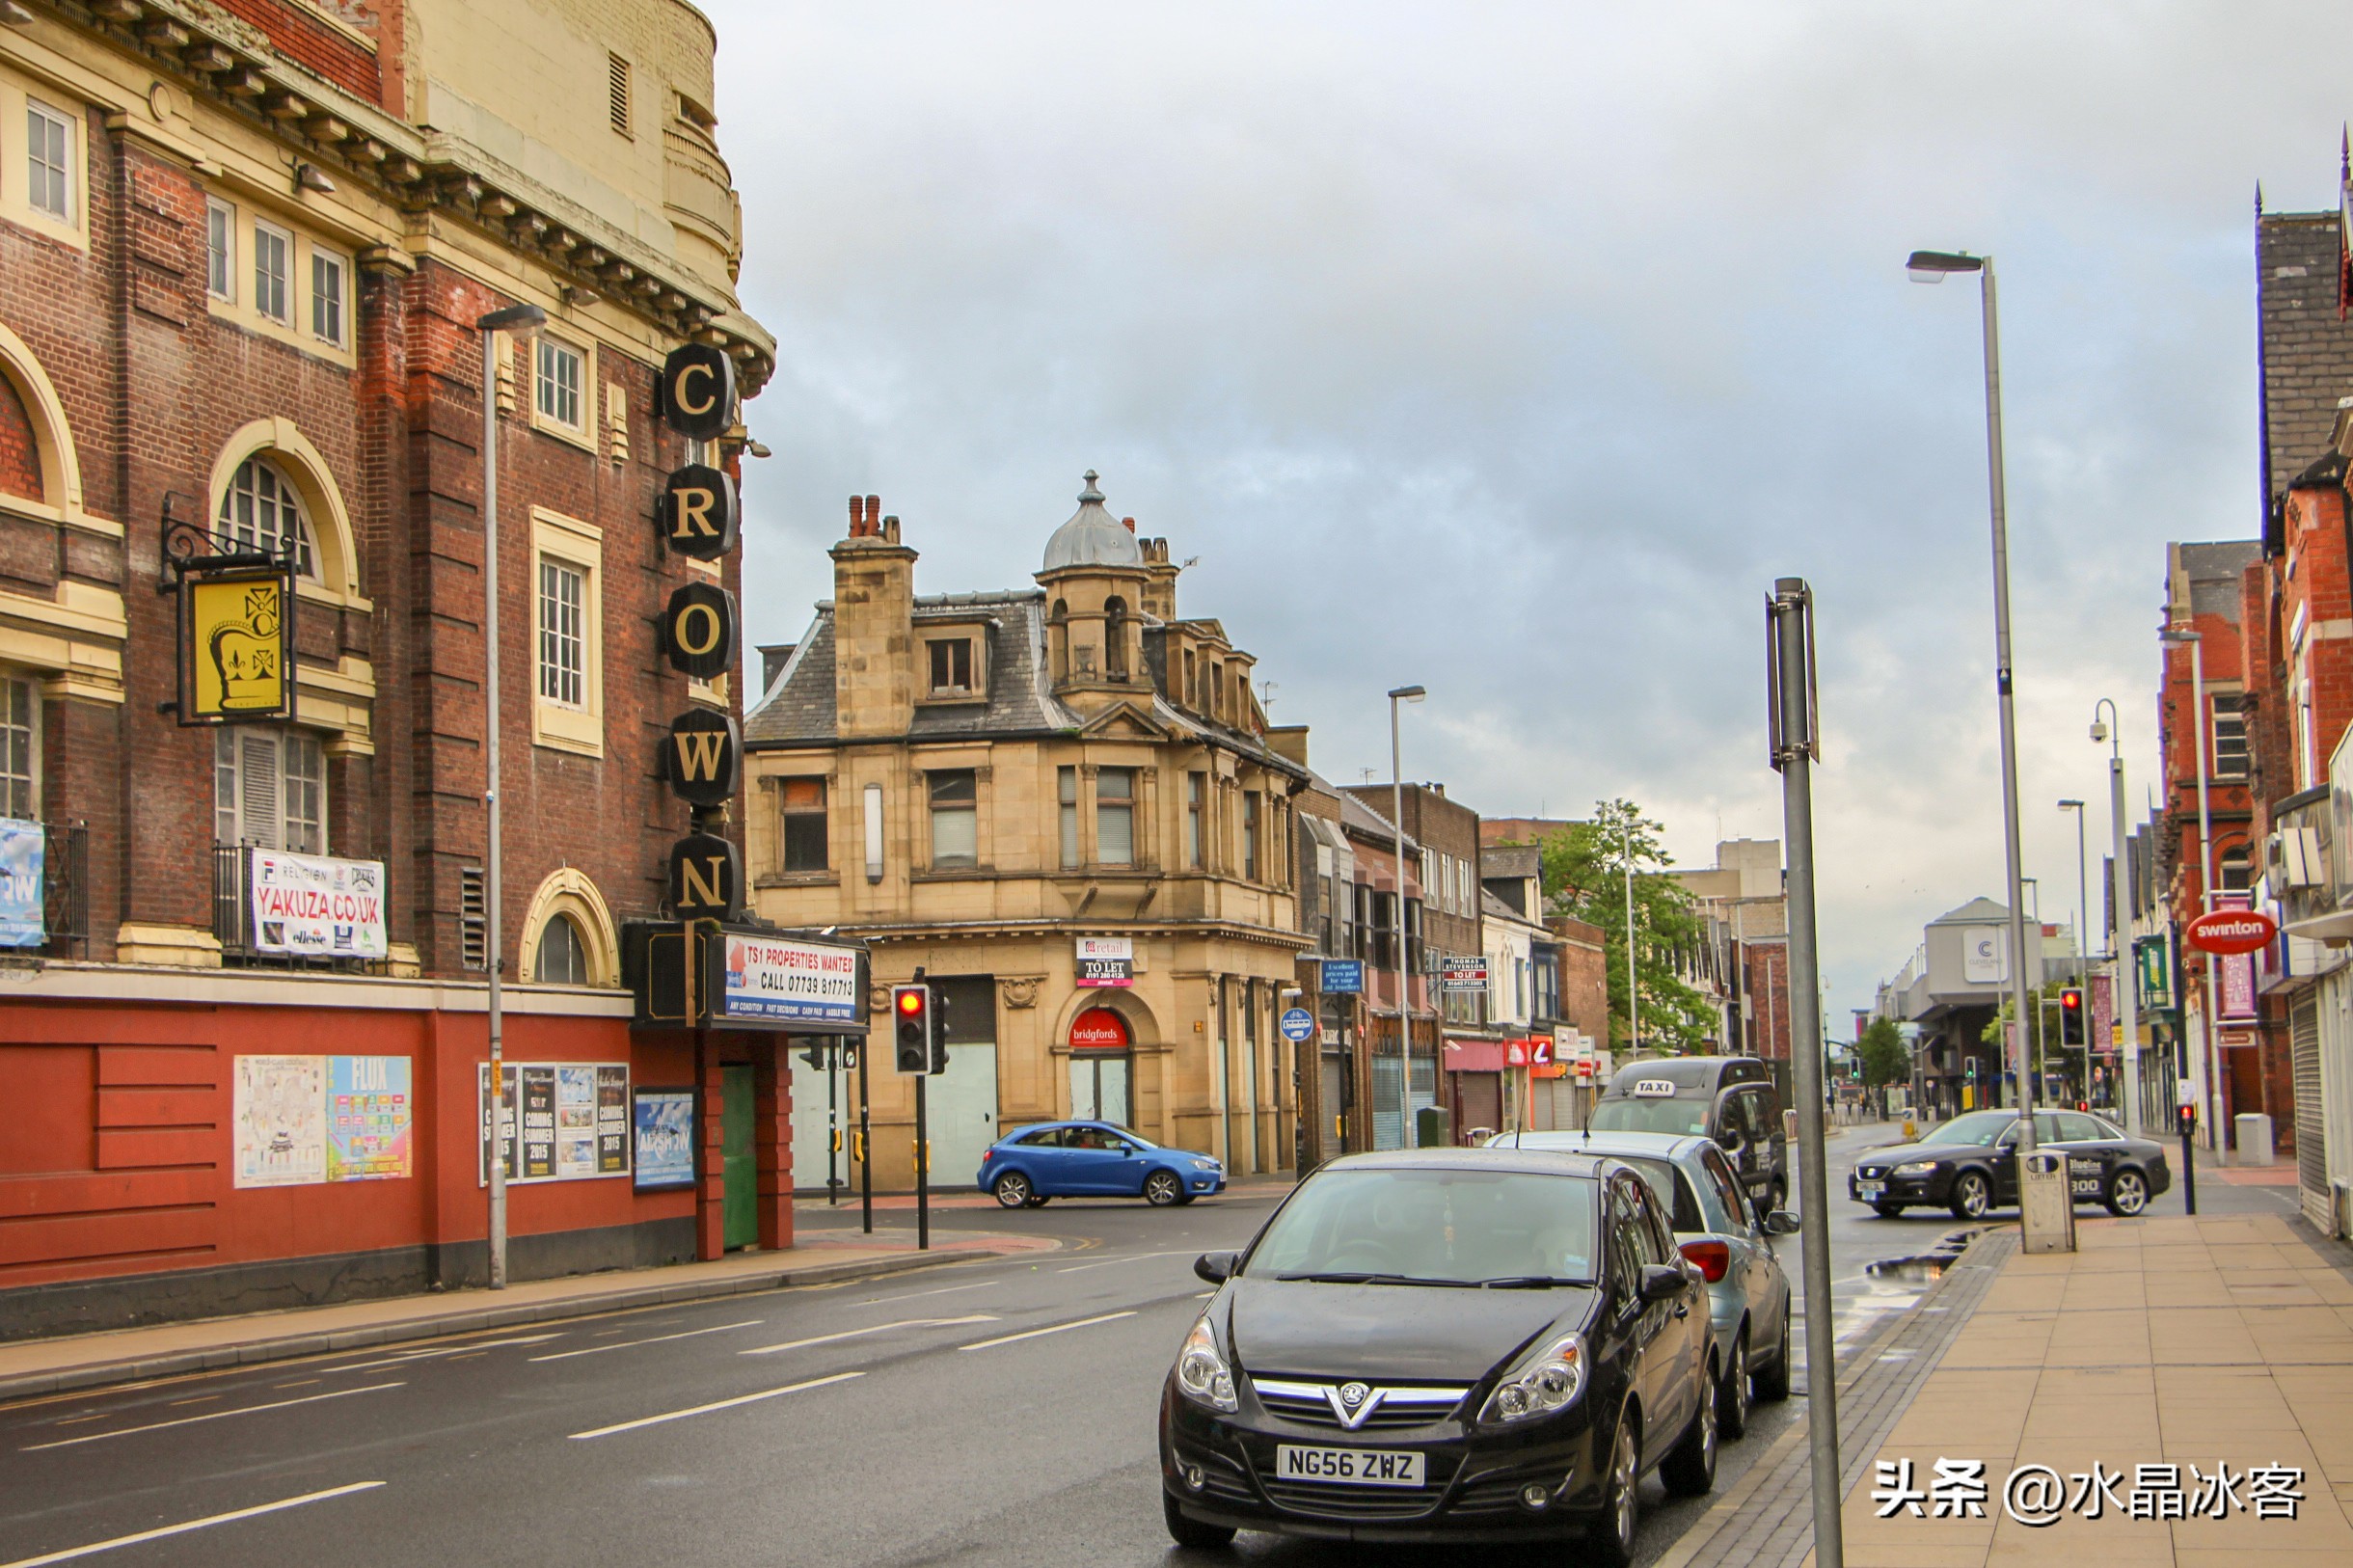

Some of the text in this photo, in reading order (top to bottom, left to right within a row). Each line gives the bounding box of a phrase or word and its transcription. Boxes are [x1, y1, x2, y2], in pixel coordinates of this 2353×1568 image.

[257, 887, 378, 924] YAKUZA.CO.UK
[2198, 920, 2263, 937] swinton
[293, 930, 326, 944] ellesse
[747, 946, 853, 973] TS1 PROPERTIES WANTED
[1086, 962, 1124, 972] TO LET
[761, 972, 784, 990] CALL
[788, 975, 818, 993] 07739
[822, 979, 852, 996] 817713
[730, 1002, 739, 1011] ANY
[740, 1002, 763, 1012] CONDITION
[766, 1004, 776, 1013] FAST
[776, 1005, 798, 1014] DECISIONS
[1073, 1029, 1118, 1041] bridgfords
[352, 1058, 388, 1091] FLUX
[1639, 1083, 1669, 1092] TAXI
[485, 1107, 514, 1124] CING
[525, 1112, 553, 1127] COMING
[599, 1105, 624, 1121] COMING
[524, 1127, 554, 1143] SUMMER
[598, 1121, 626, 1136] SUMMER
[604, 1136, 620, 1151] 2015
[529, 1145, 548, 1159] 2015
[1288, 1449, 1354, 1477] NG56
